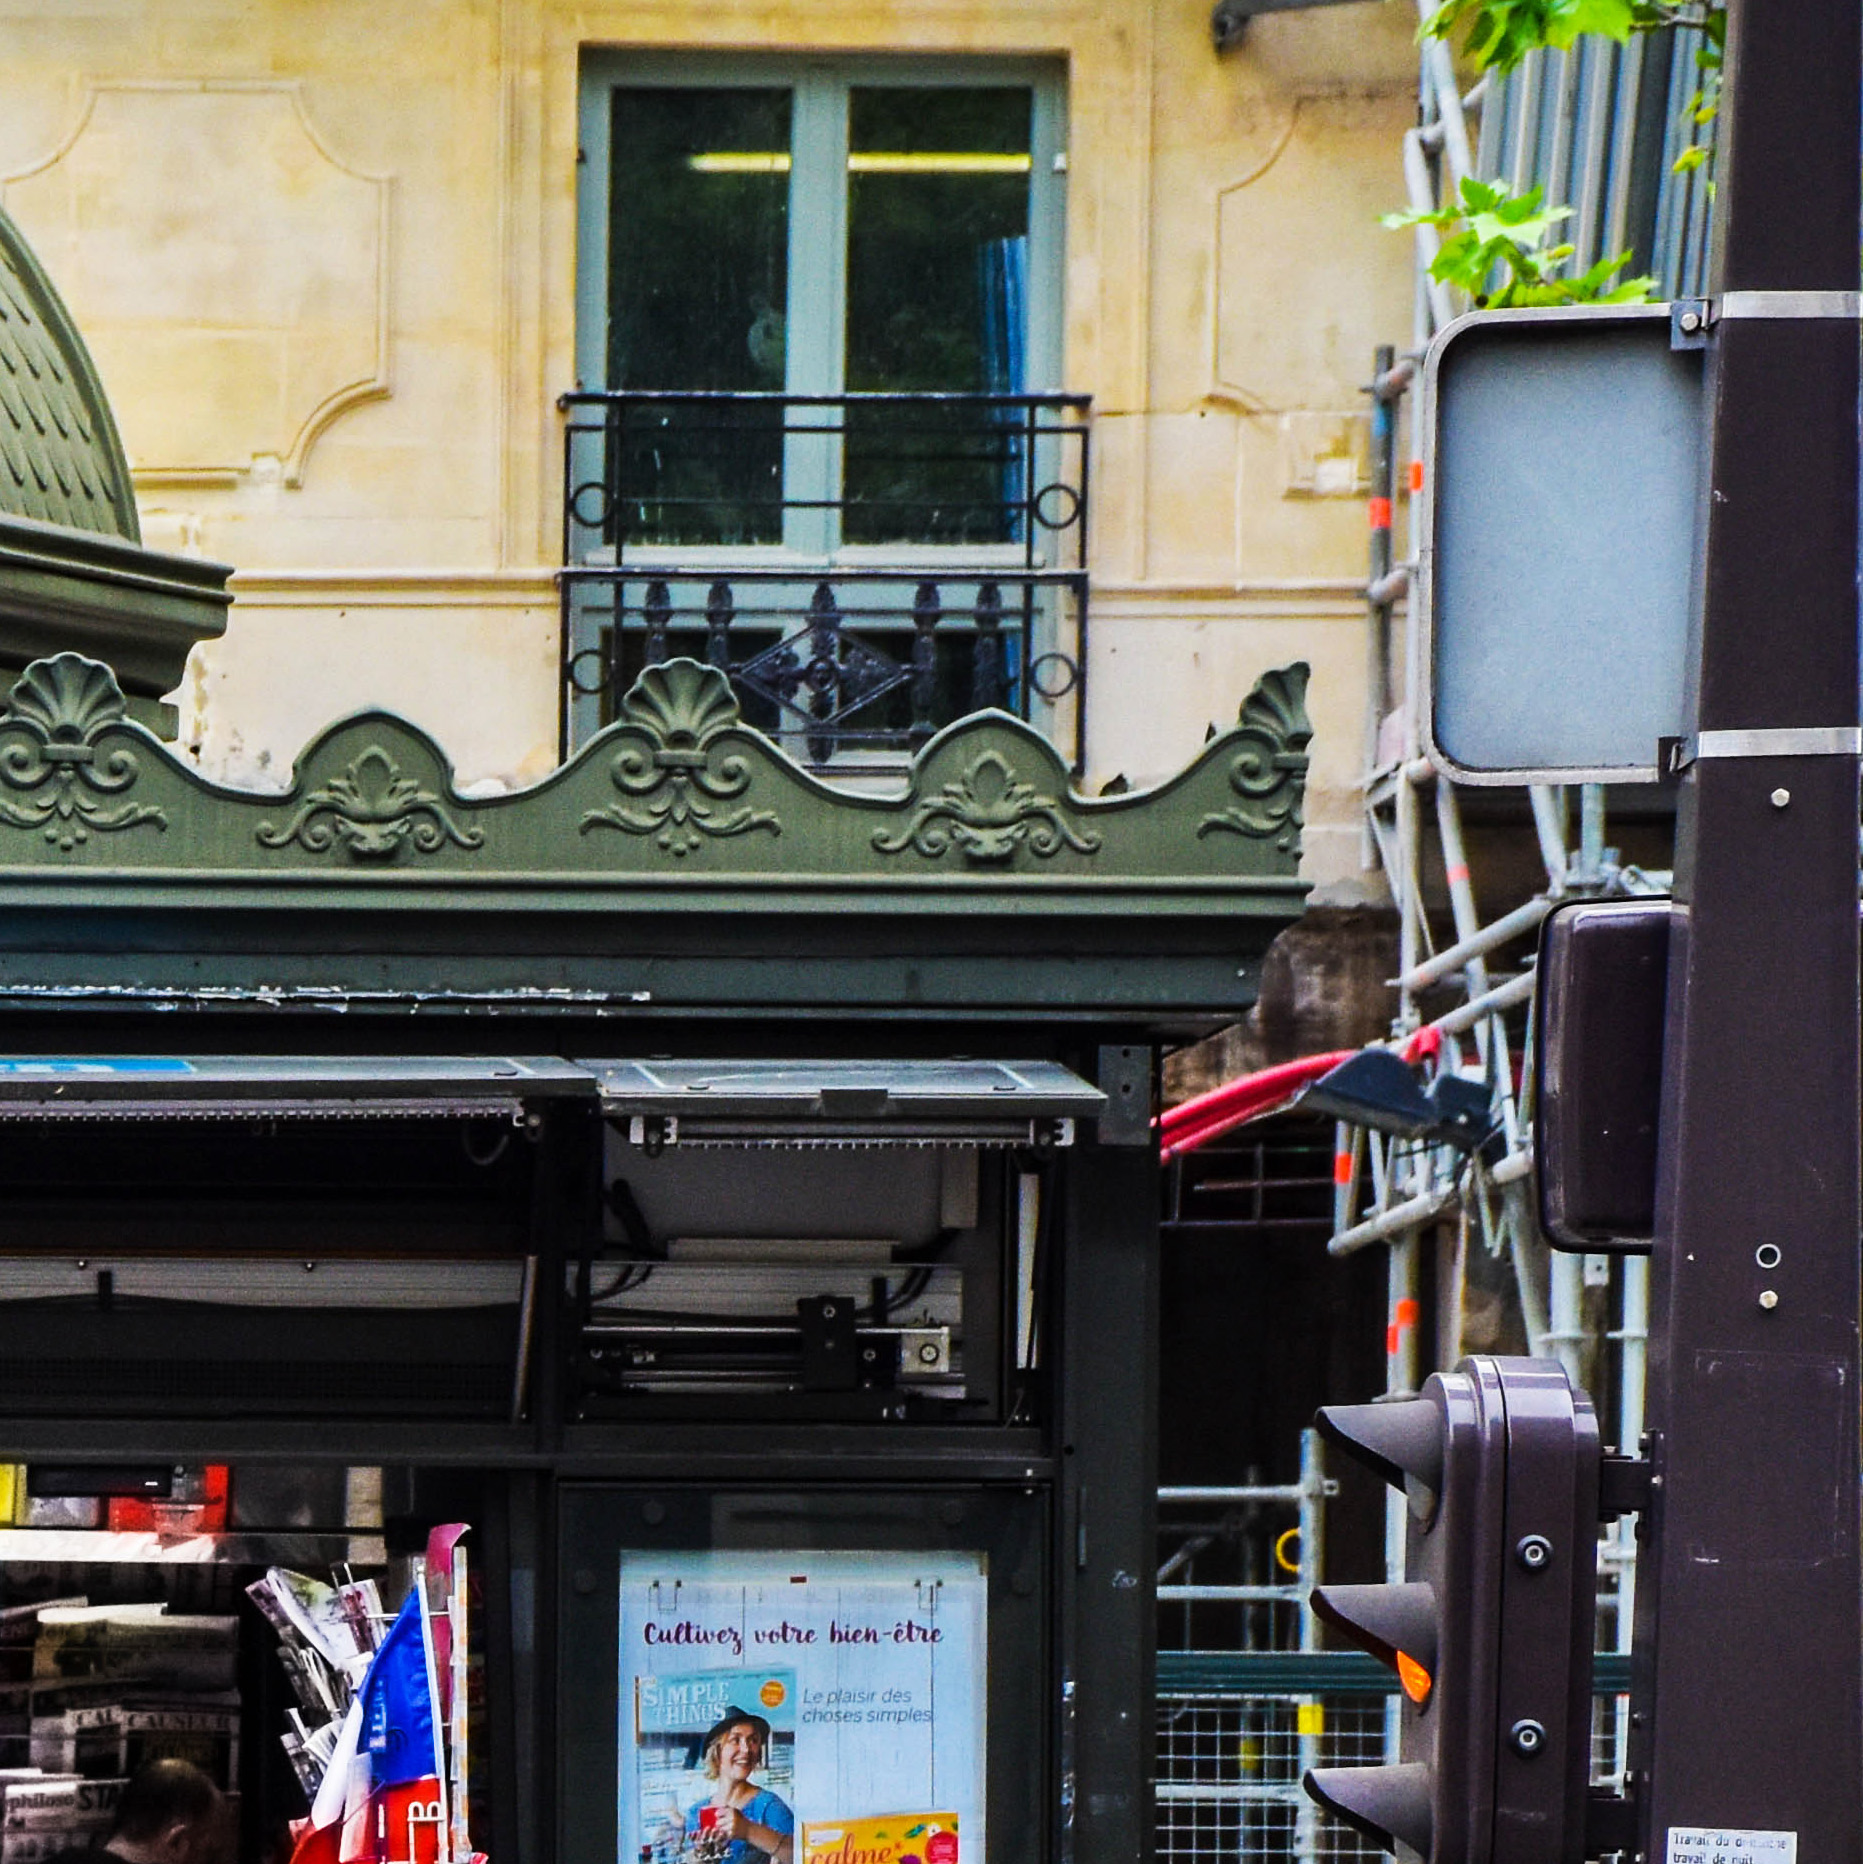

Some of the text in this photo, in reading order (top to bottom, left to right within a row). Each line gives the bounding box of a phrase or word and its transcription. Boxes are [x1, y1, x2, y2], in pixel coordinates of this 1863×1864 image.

[644, 1620, 943, 1655] Cultivez votre bien-être
[642, 1681, 730, 1707] SIMPLE
[803, 1688, 911, 1708] Le plaisir des
[656, 1702, 726, 1726] THINGS
[802, 1706, 932, 1724] choses simples
[1716, 1834, 1729, 1847] du
[1712, 1852, 1726, 1864] de
